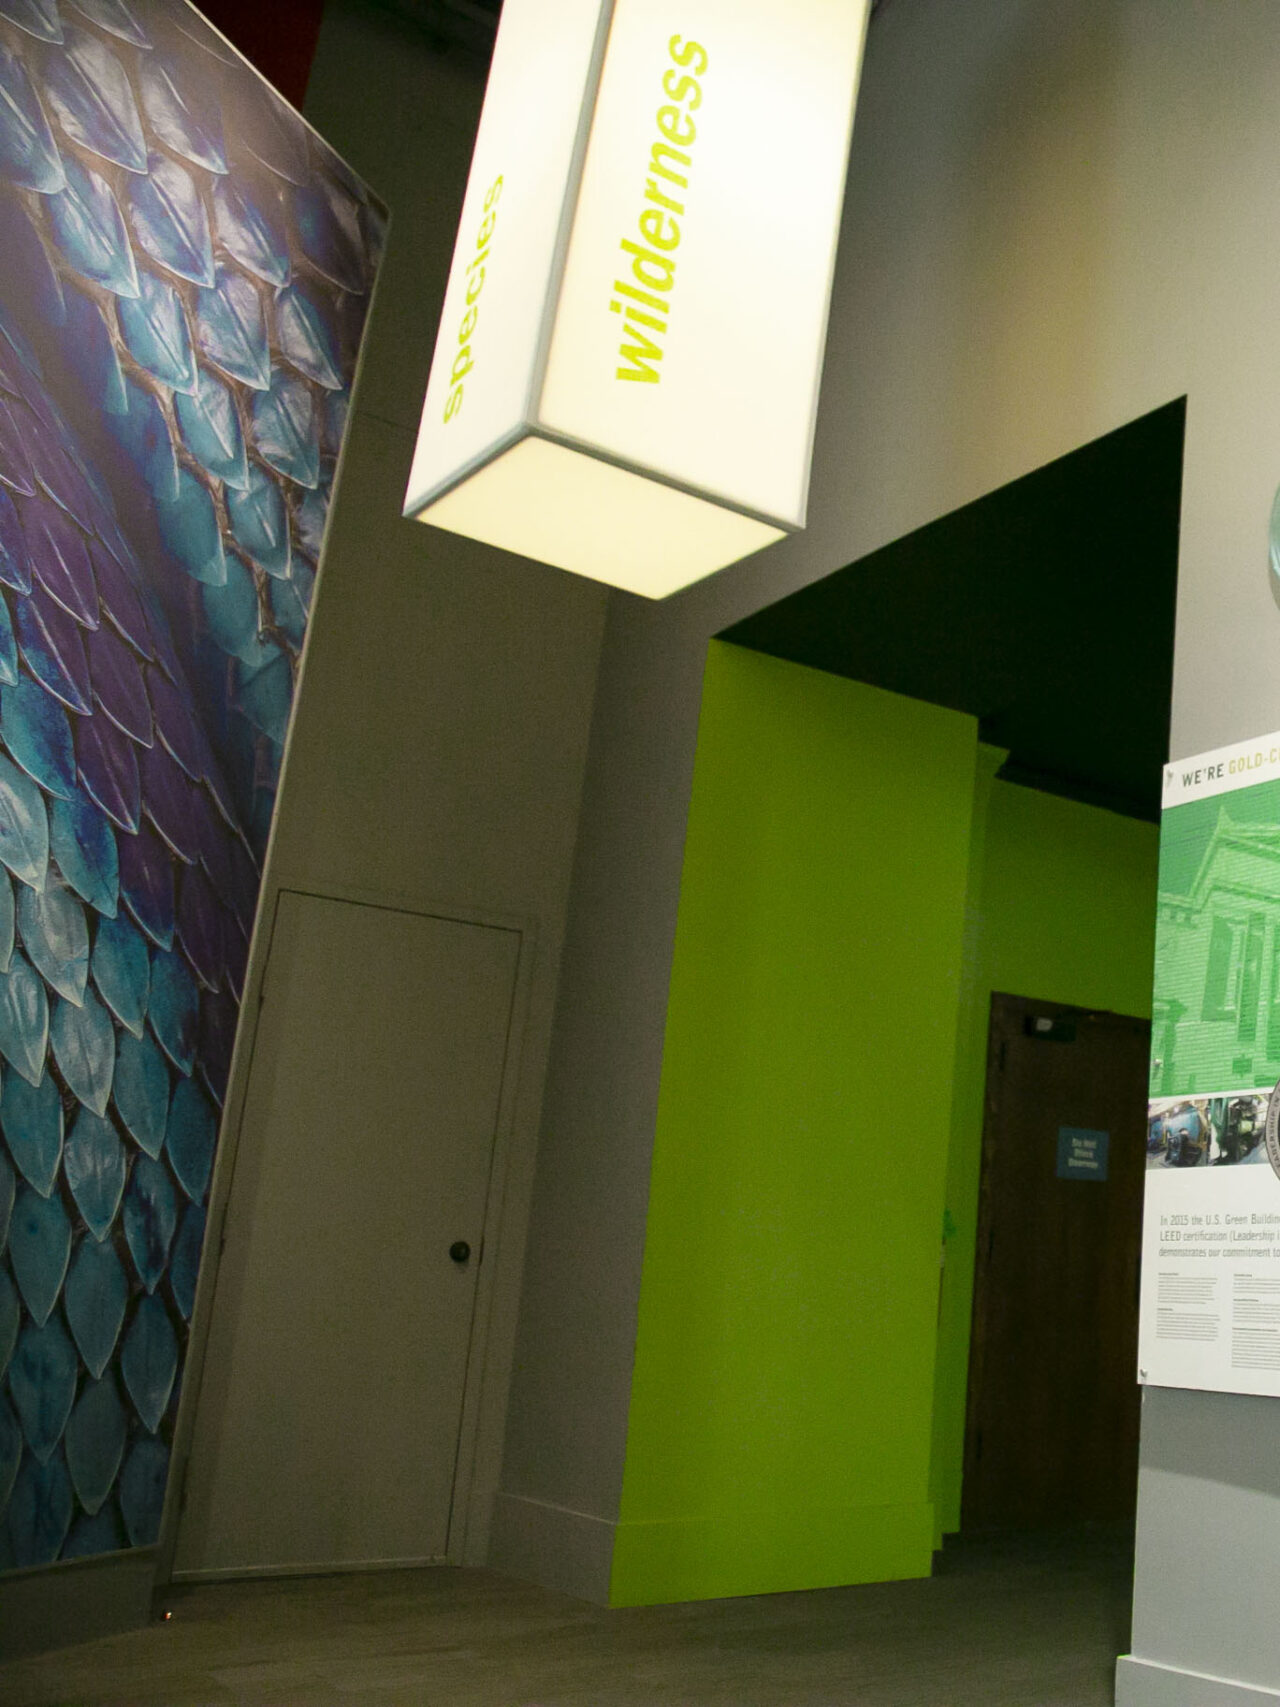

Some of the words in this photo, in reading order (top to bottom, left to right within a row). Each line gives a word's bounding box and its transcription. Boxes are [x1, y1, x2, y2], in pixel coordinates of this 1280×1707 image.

[609, 33, 708, 385] wilderness
[443, 174, 503, 425] species
[1182, 763, 1224, 788] WE'RE
[1160, 1215, 1168, 1226] In
[1170, 1214, 1189, 1226] 2015
[1191, 1214, 1203, 1225] the
[1206, 1214, 1221, 1225] U.S.
[1225, 1213, 1248, 1225] Green
[1160, 1230, 1181, 1242] LEED
[1183, 1229, 1227, 1241] certification
[1229, 1229, 1274, 1243] (Leadership
[1208, 1249, 1220, 1257] our
[1222, 1247, 1271, 1258] commitment
[1273, 1247, 1280, 1257] to
